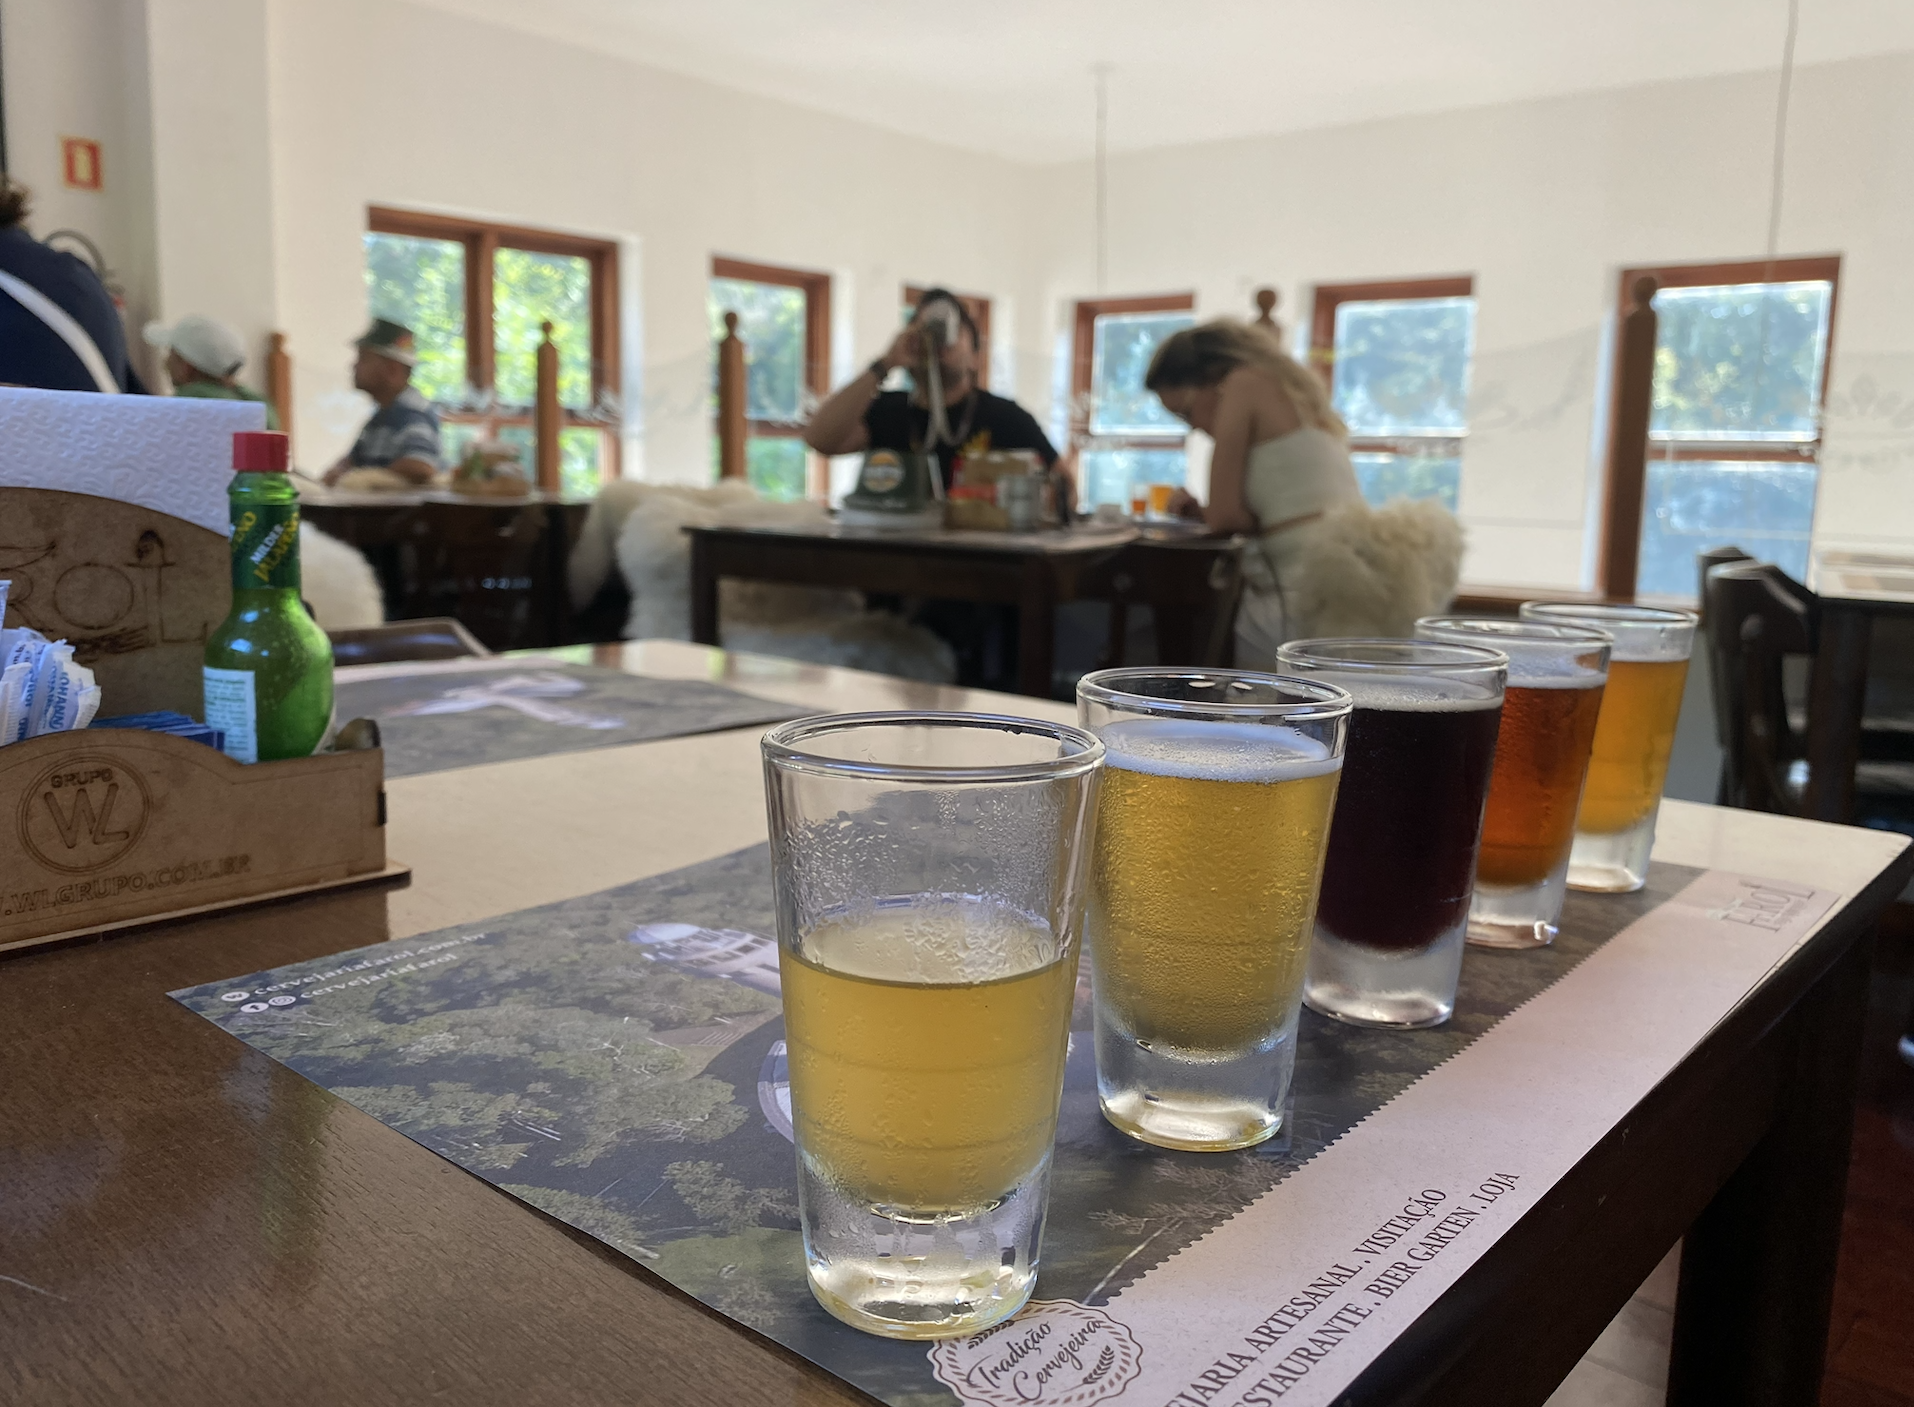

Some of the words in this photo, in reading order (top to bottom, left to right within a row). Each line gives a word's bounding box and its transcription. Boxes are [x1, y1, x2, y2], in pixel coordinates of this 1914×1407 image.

[51, 768, 114, 789] GRUPO
[43, 783, 130, 849] WL
[254, 931, 488, 996] cervejariafarol.com.br
[300, 952, 460, 999] cervejariafarol
[1232, 1302, 1373, 1407] STAURANTE
[1363, 1261, 1423, 1299] BIER
[1406, 1206, 1480, 1262] GARTEN
[1469, 1172, 1521, 1204] LOJA
[1243, 1263, 1363, 1354] ARTESANAL
[1352, 1188, 1447, 1256] VISITAÇÃO
[966, 1320, 1052, 1389] Tradição
[1013, 1320, 1103, 1401] Cervejeira
